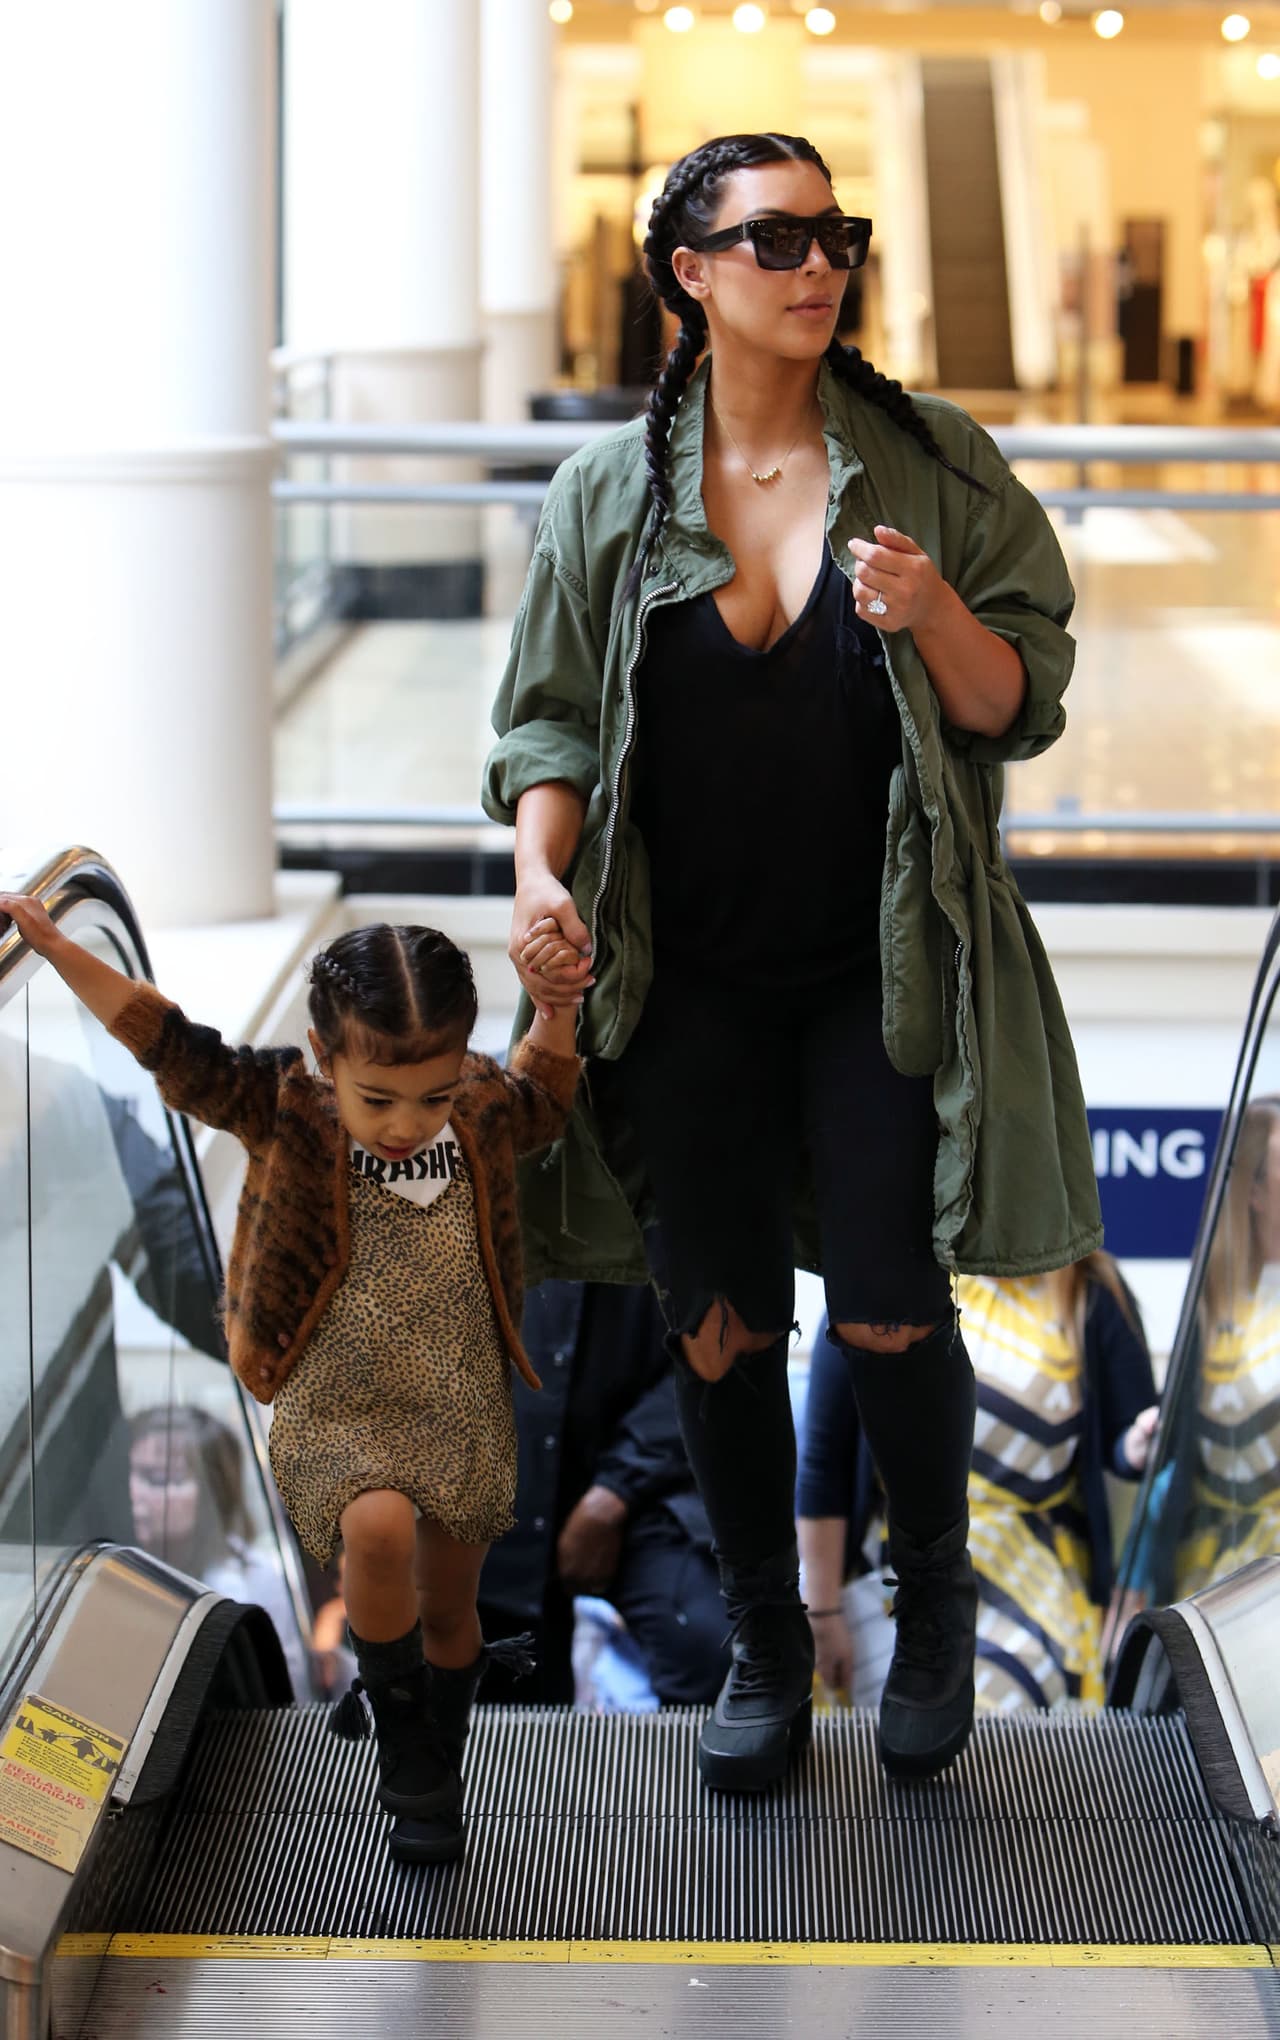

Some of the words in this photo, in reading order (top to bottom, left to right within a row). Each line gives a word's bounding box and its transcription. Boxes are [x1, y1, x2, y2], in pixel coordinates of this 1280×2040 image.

[1093, 1128, 1206, 1179] ING
[40, 1704, 110, 1743] CAUTION
[3, 1767, 86, 1810] SEGURIDAD
[7, 1762, 64, 1794] REGLAS
[67, 1791, 87, 1803] DE
